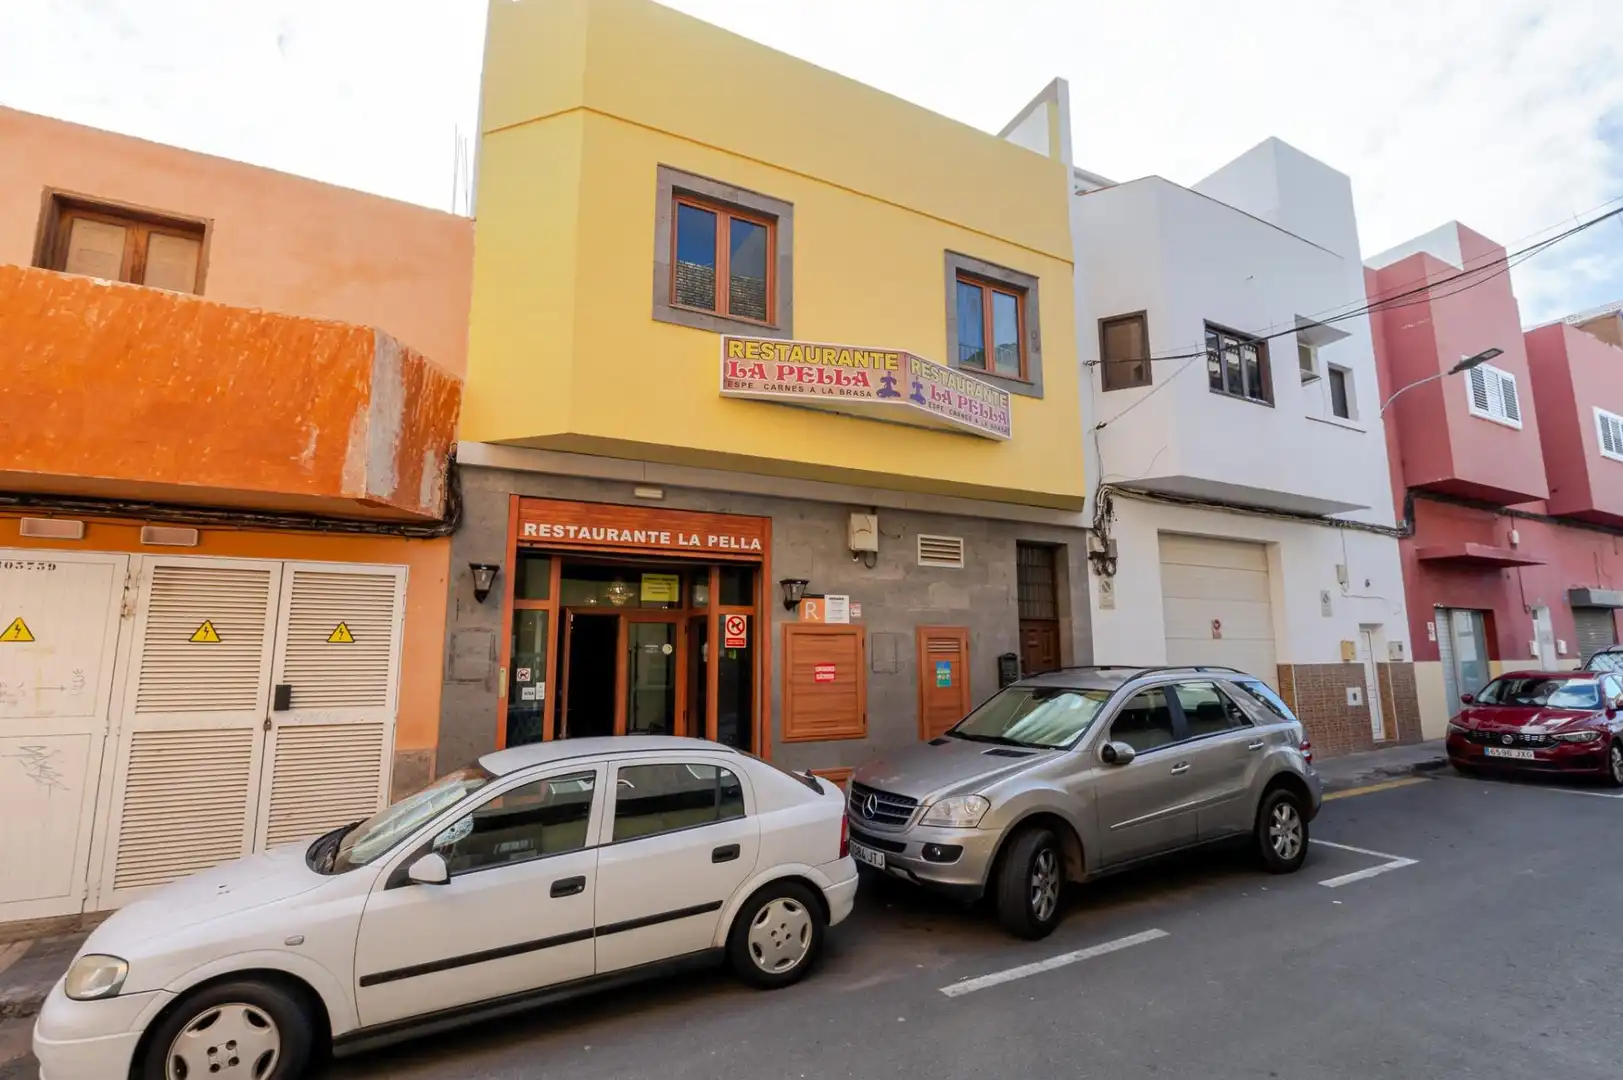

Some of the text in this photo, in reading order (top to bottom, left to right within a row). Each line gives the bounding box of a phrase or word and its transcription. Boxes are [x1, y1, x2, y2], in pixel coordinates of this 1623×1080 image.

[728, 340, 899, 371] RESTAURANTE
[728, 361, 871, 388] LA PELLA
[910, 358, 1008, 408] RESTAURANTE
[728, 380, 753, 389] ESPE
[764, 383, 804, 393] CARNES
[822, 387, 834, 395] LA
[840, 389, 872, 398] BRASA
[930, 383, 1007, 425] LA PELLA
[524, 522, 762, 550] RESTAURANTE LA PELLA
[805, 601, 820, 620] R
[868, 848, 884, 865] JTJ
